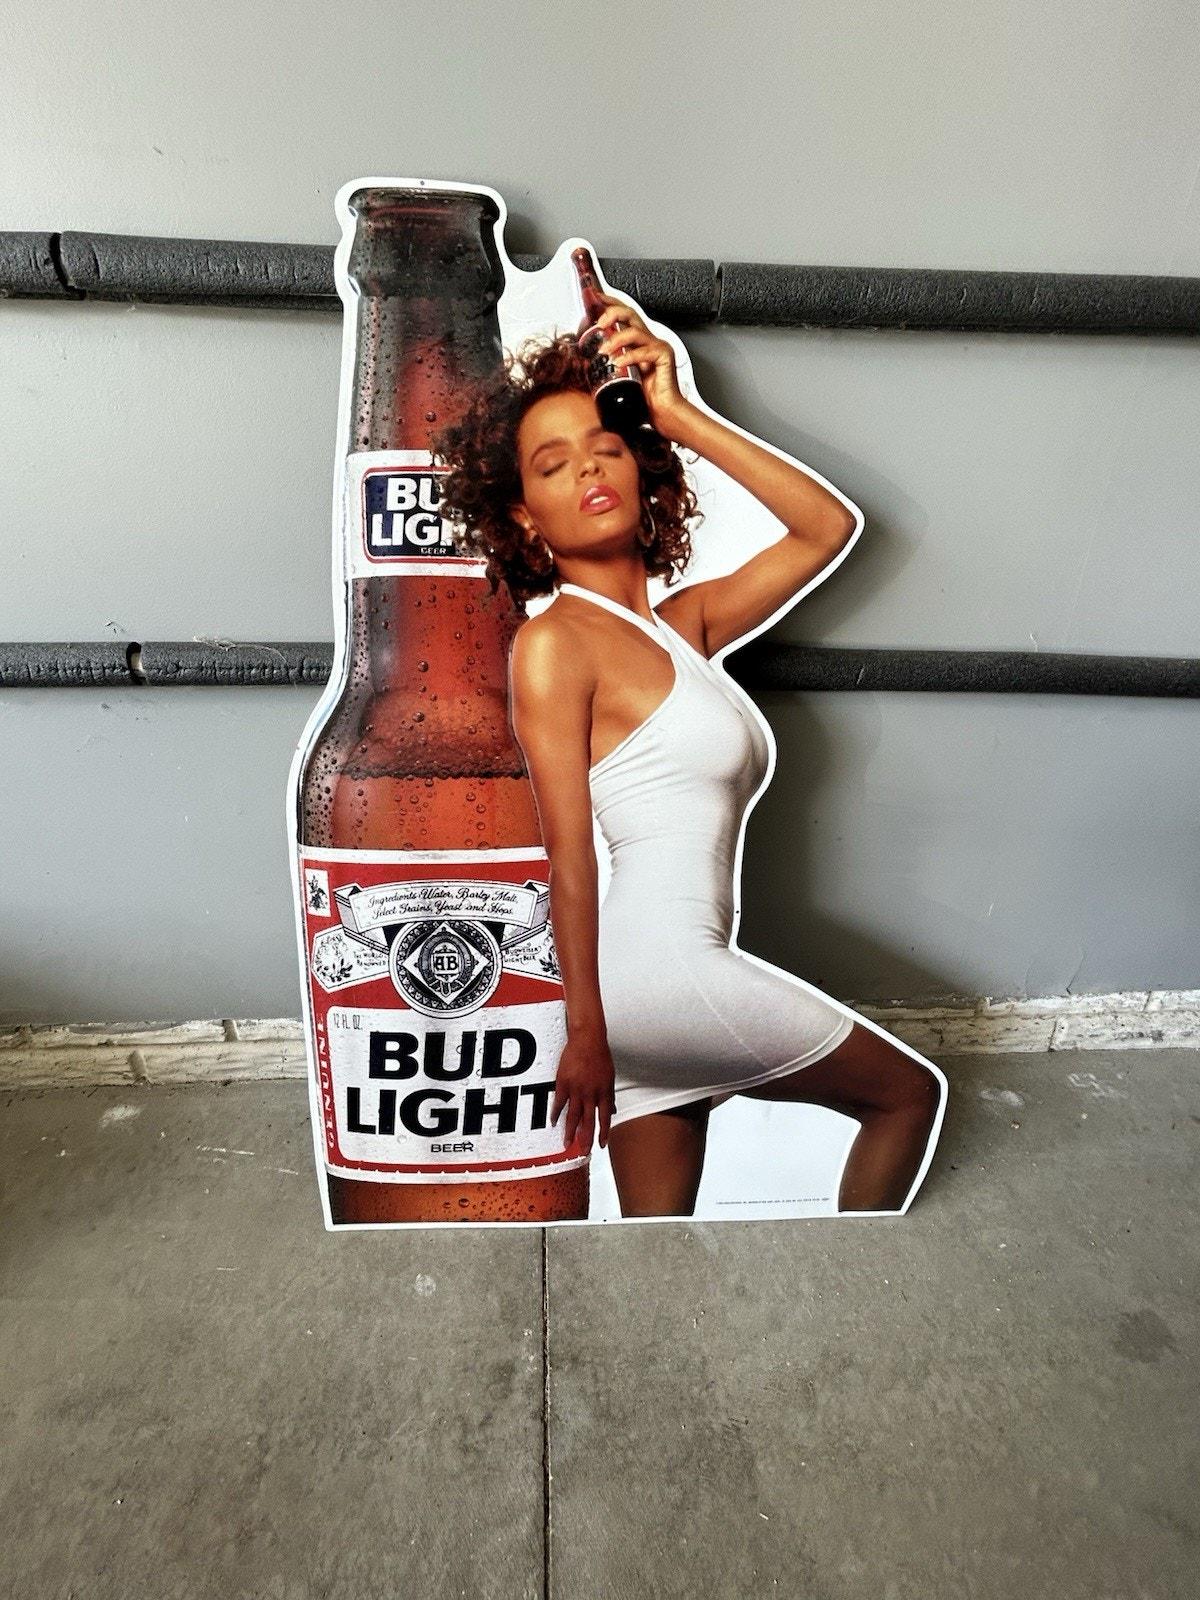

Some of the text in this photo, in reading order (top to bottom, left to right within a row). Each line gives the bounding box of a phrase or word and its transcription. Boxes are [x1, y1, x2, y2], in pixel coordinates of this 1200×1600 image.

[386, 477, 449, 511] BU
[434, 900, 462, 915] Yeast
[465, 903, 487, 912] and
[455, 887, 490, 902] Barley
[368, 1028, 537, 1081] BUD
[317, 1013, 336, 1149] GENUINE
[346, 1080, 556, 1138] LIGHT
[430, 1141, 474, 1153] BEER
